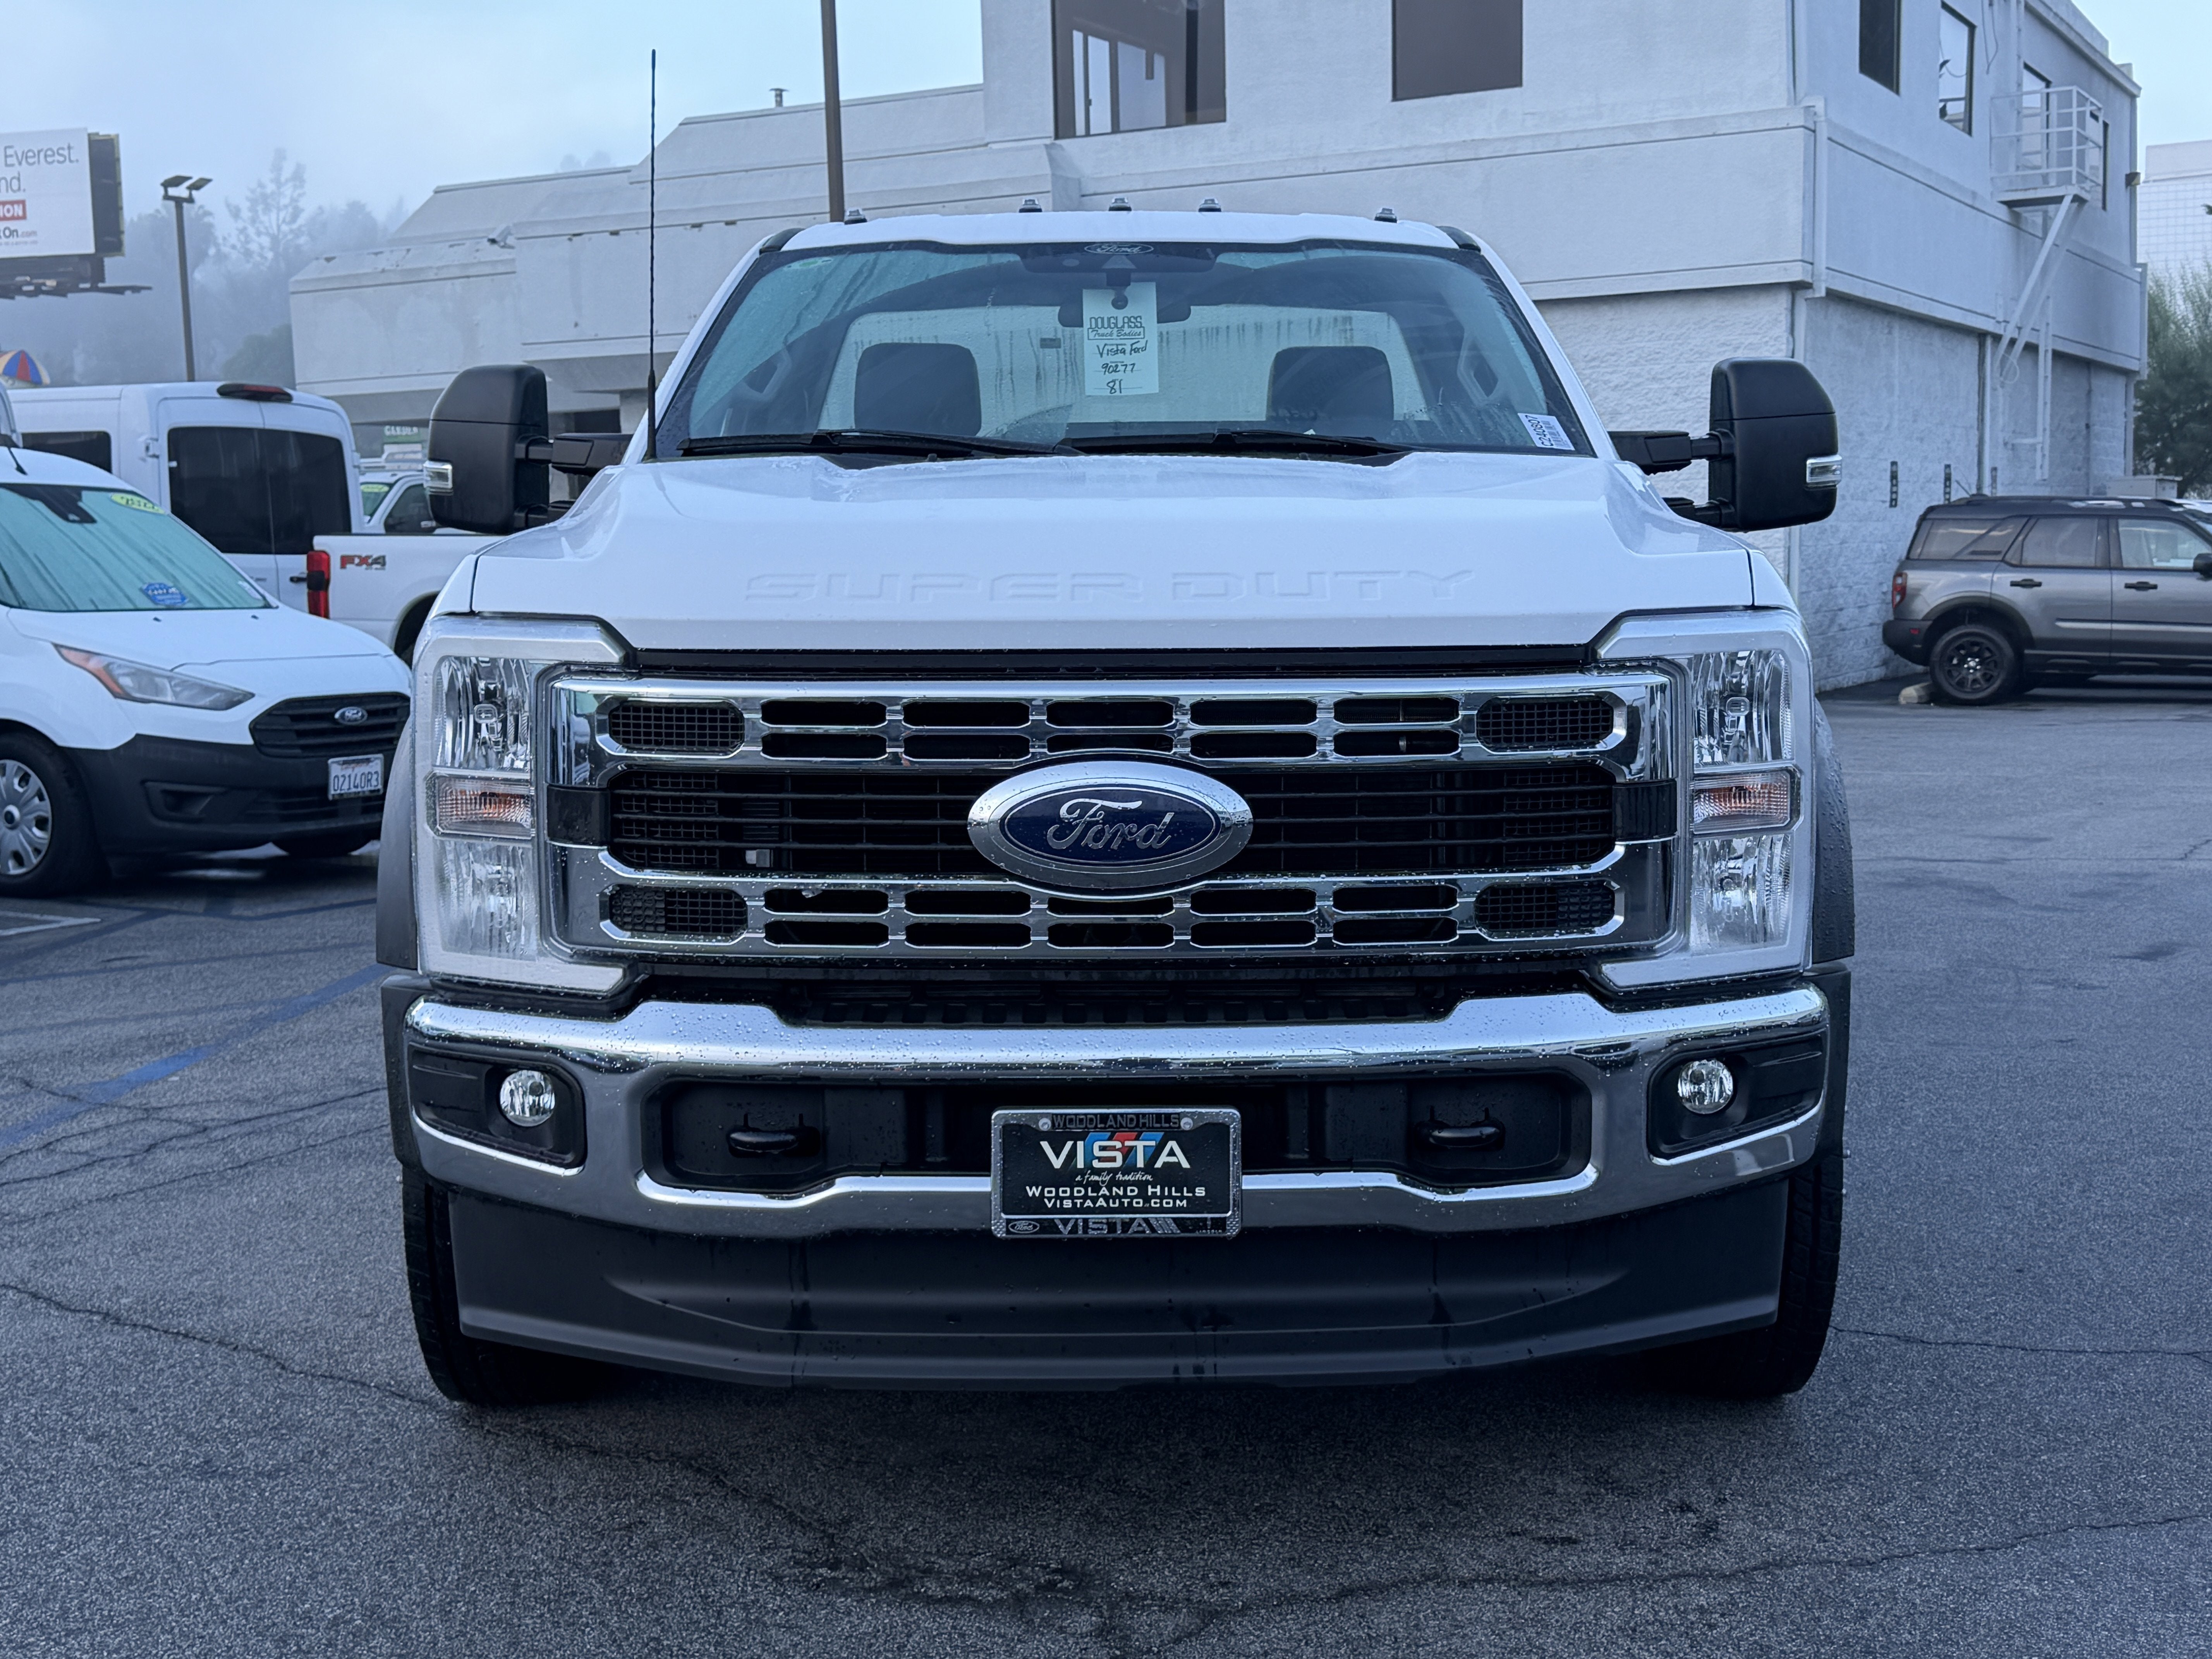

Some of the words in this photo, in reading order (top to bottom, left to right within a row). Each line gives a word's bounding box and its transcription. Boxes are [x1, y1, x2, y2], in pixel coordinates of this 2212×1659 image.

[4, 143, 79, 167] Everest.
[1090, 316, 1142, 329] DOUGLASS
[1091, 329, 1114, 338] Truck
[1116, 329, 1141, 337] Bodies
[1096, 343, 1126, 358] Vista
[1129, 340, 1148, 356] Ford
[1101, 363, 1135, 375] 90277
[340, 555, 386, 569] FX4
[744, 572, 1144, 603] SUPER
[1172, 570, 1475, 601] DUTY
[1047, 798, 1175, 850] Ford
[1053, 1115, 1137, 1128] WOODLAND
[1139, 1114, 1180, 1128] HILLS
[1040, 1140, 1191, 1169] VISTA
[1083, 1170, 1113, 1187] family
[1115, 1170, 1154, 1182] tradition
[1054, 1218, 1151, 1234] VISTA
